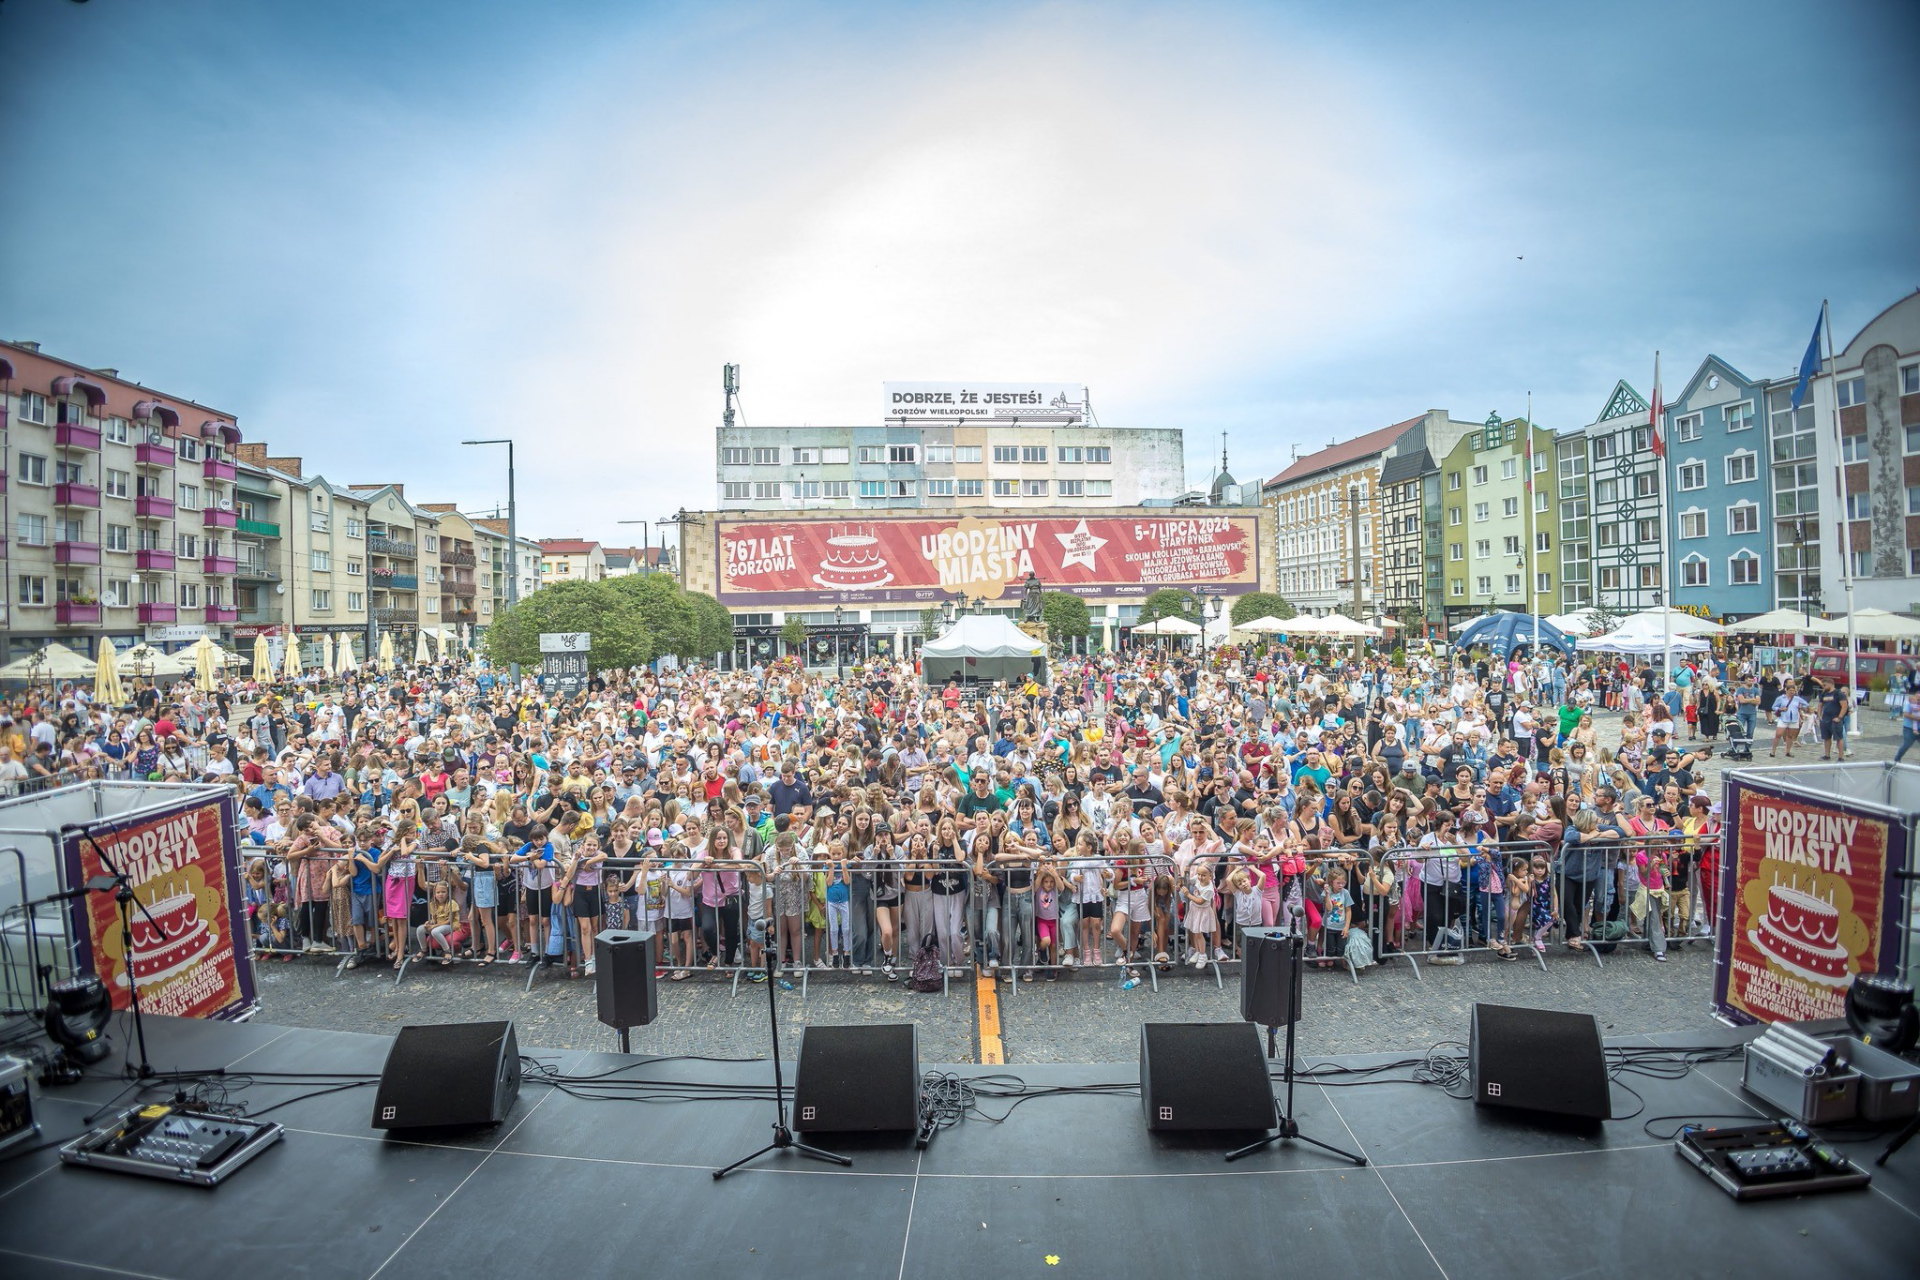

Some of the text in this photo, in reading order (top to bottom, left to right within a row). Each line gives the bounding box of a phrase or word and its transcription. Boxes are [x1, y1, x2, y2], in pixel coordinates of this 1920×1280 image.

[892, 389, 1042, 405] DOBRZE, ŻE JESTEŚ!
[892, 407, 927, 415] GORZÓW
[1159, 520, 1198, 539] LIPCA
[1199, 517, 1230, 534] 2024
[1160, 533, 1214, 548] STARY RYNEK
[726, 535, 795, 563] 767 LAT
[921, 523, 1038, 561] URODZINY
[728, 555, 797, 577] GORZOWA
[938, 549, 1036, 586] MIASTA
[1125, 552, 1151, 562] SKOLIM
[1170, 548, 1194, 558] LATINO
[1144, 557, 1168, 568] MAJKA
[1206, 552, 1225, 561] BAND
[1188, 559, 1229, 571] OSTROWSKA
[1164, 571, 1194, 582] GRUBASA
[1753, 805, 1858, 846] URODZINY
[100, 811, 199, 873] URODZINY
[1765, 831, 1853, 876] MIASTA
[117, 836, 201, 889] MIASTA
[157, 976, 184, 999] LATINO
[188, 948, 233, 978] BARANOVSKI
[197, 967, 217, 984] BAND
[1732, 958, 1759, 977] SKOLIM
[1760, 969, 1779, 984] KRÓL
[1779, 975, 1808, 993] LATINO
[1750, 974, 1778, 994] MAJKA
[179, 972, 223, 1003] OSTROWSKA
[1744, 991, 1769, 1010] ŁYDKA
[1768, 1002, 1805, 1022] GRUBASA
